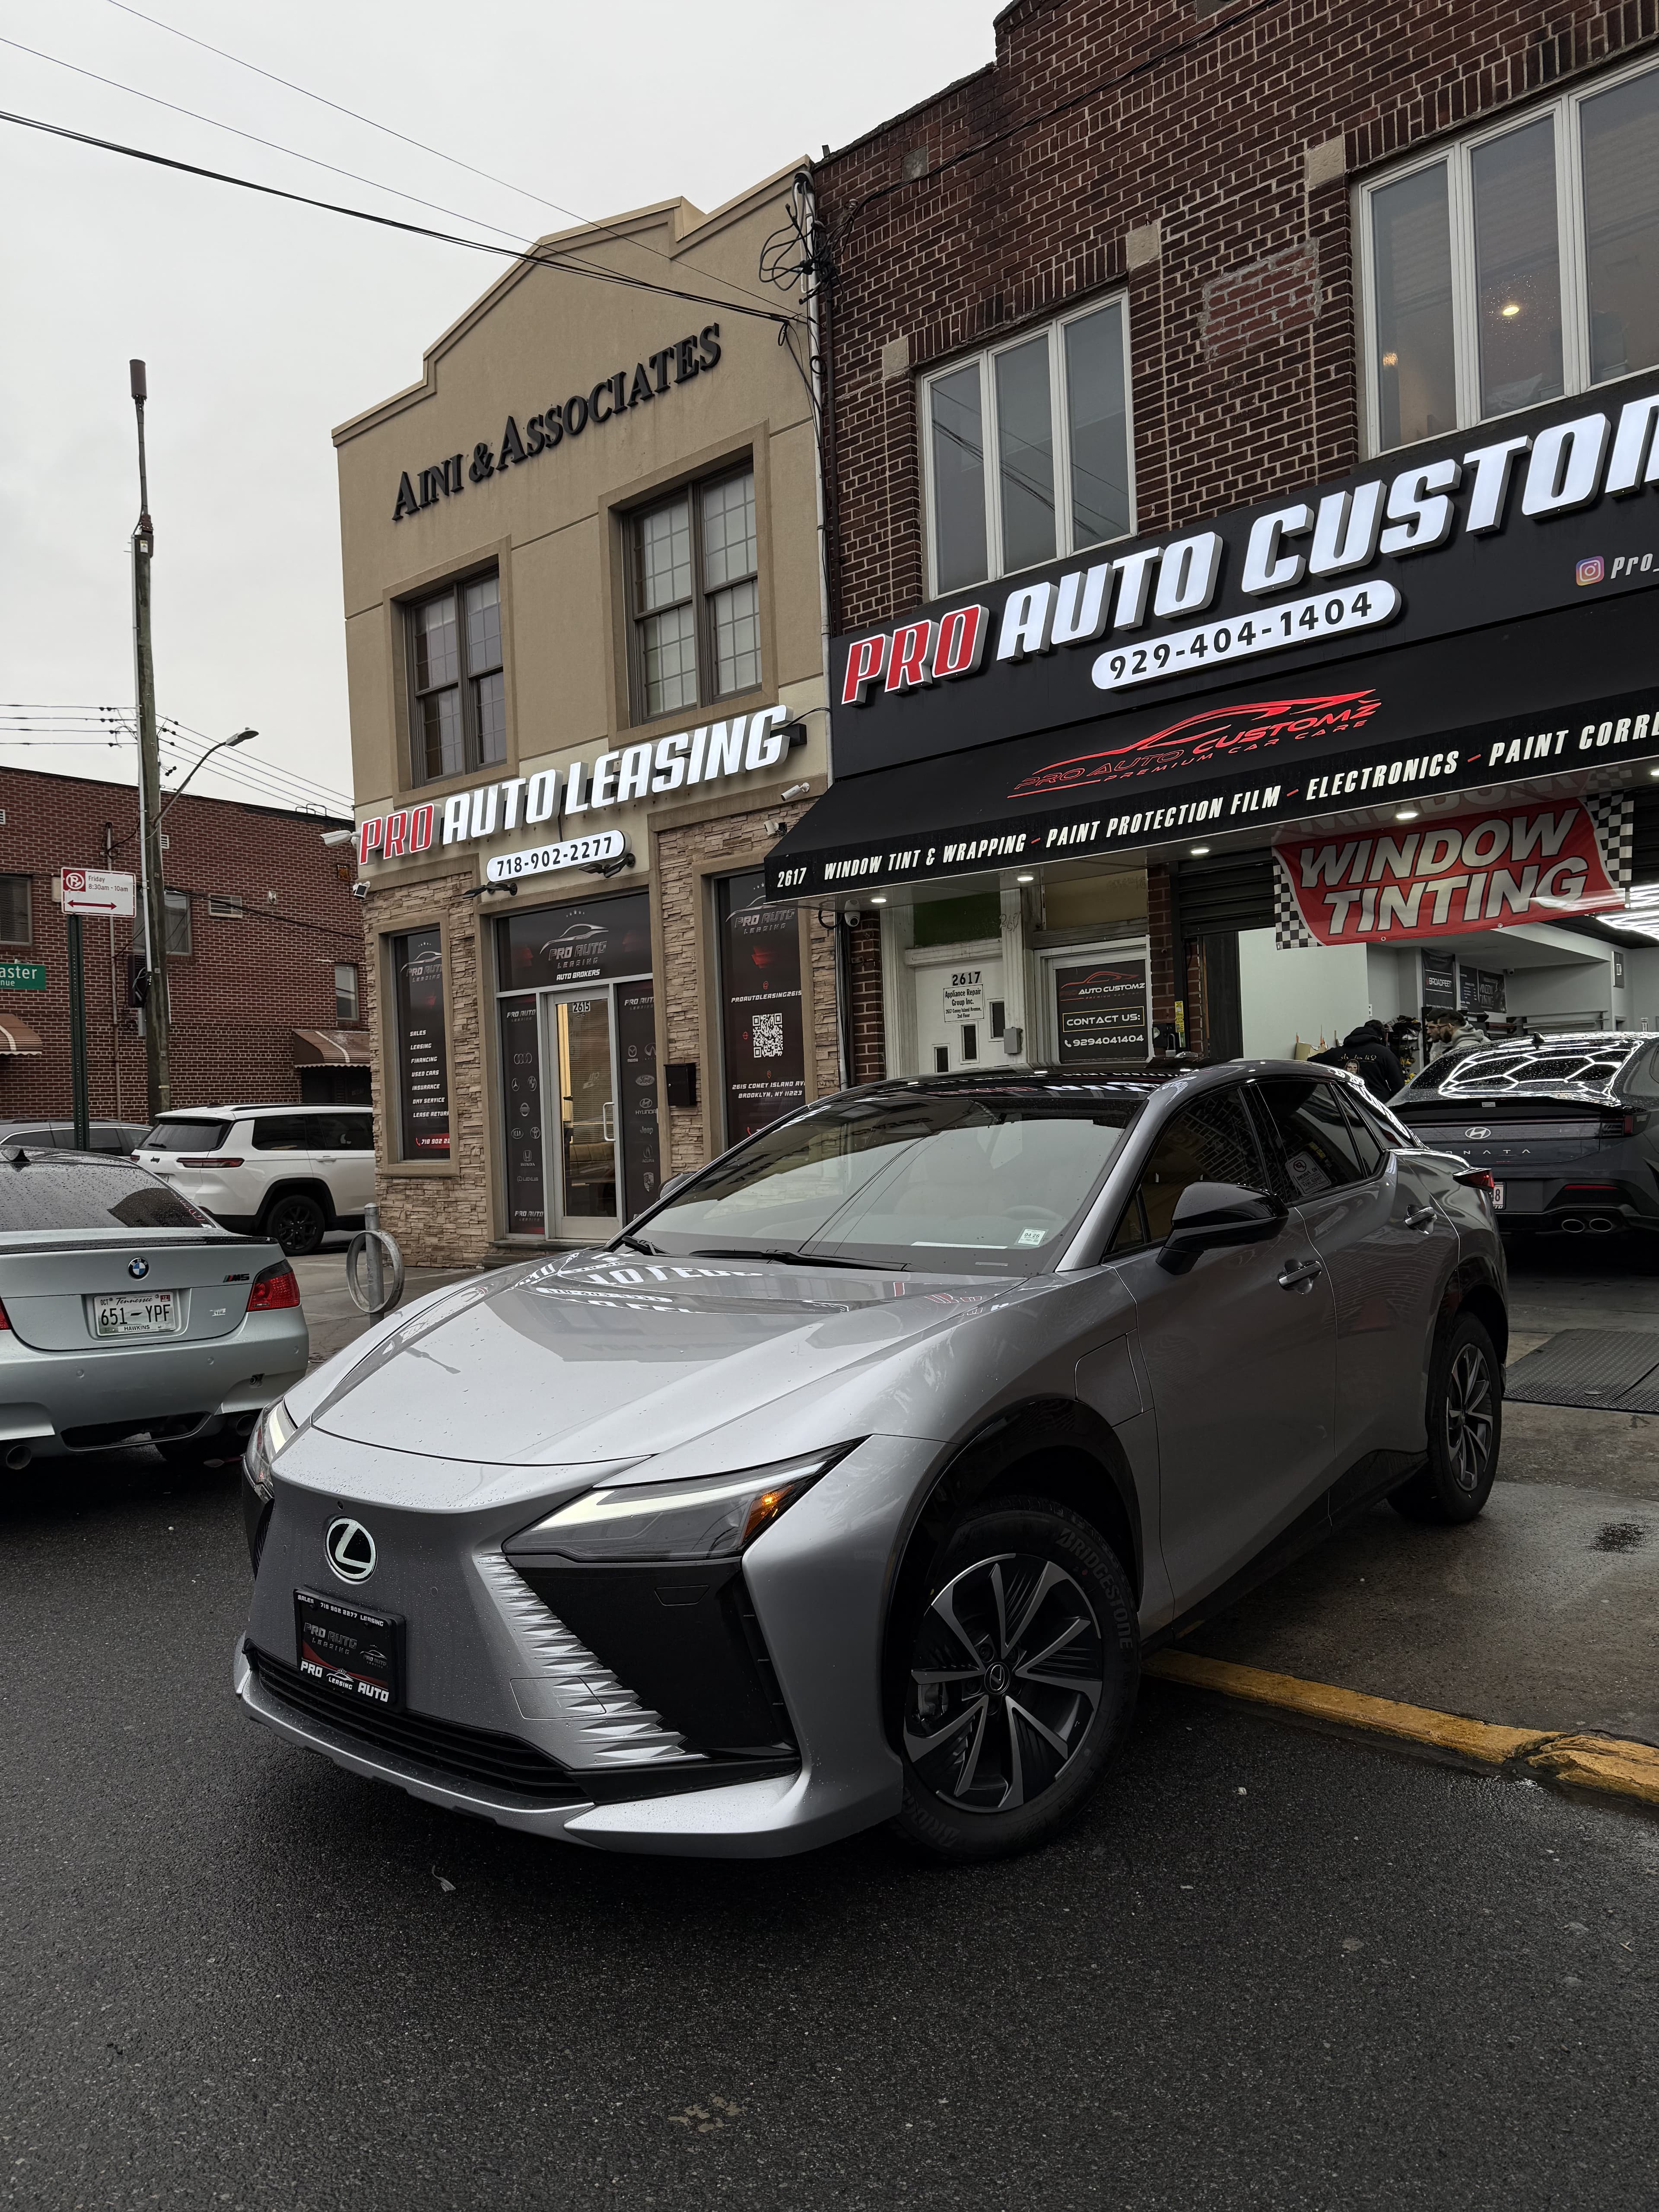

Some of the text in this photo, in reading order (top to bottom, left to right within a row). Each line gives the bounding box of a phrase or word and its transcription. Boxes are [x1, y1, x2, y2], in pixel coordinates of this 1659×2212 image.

[392, 322, 721, 521] AINI & ASSOCIATES
[841, 604, 989, 705] PRO
[997, 531, 1223, 661] AUTO
[1110, 591, 1372, 680] 929-404-1404
[1014, 699, 1382, 790] PRO AUTO CUSTOMZ
[1103, 720, 1367, 782] PREMIUM CAR CARE
[359, 705, 794, 865] PRO AUTO LEASING
[778, 868, 807, 888] 2617
[824, 855, 882, 880] WINDOW
[888, 849, 921, 871] TINT
[926, 848, 936, 866] &
[943, 833, 1027, 863] WRAPPING
[1046, 821, 1100, 847] PAINT
[1107, 798, 1224, 835] PROTECTION
[1230, 785, 1281, 814] FILM
[1306, 751, 1459, 800] ELECTRONICS
[1489, 730, 1569, 766] PAINT
[498, 837, 612, 877] 718-902-2277
[1300, 808, 1582, 889] WINDOW
[1323, 856, 1588, 935] TINTING
[734, 909, 795, 928] PRO AUTO
[744, 923, 786, 934] LEASING
[549, 941, 607, 961] PRO AUTO
[557, 957, 598, 969] LEASING
[407, 966, 423, 976] PRO
[572, 969, 601, 979] BROKERS
[953, 971, 981, 985] 2617
[945, 988, 981, 999] Appliance Repair
[1103, 982, 1145, 992] CUSTOMZ
[573, 1002, 590, 1012] 2615
[1067, 1015, 1119, 1026] CONTACT
[1073, 1034, 1144, 1046] 9294041404
[116, 1297, 153, 1305] Tennessee
[1055, 1528, 1133, 1649] BRIDGESTONE
[298, 1595, 314, 1604] SALES
[360, 1615, 384, 1627] LEASING
[304, 1622, 357, 1649] PRO AUTO
[301, 1661, 389, 1702] PRO LEASING AUTO
